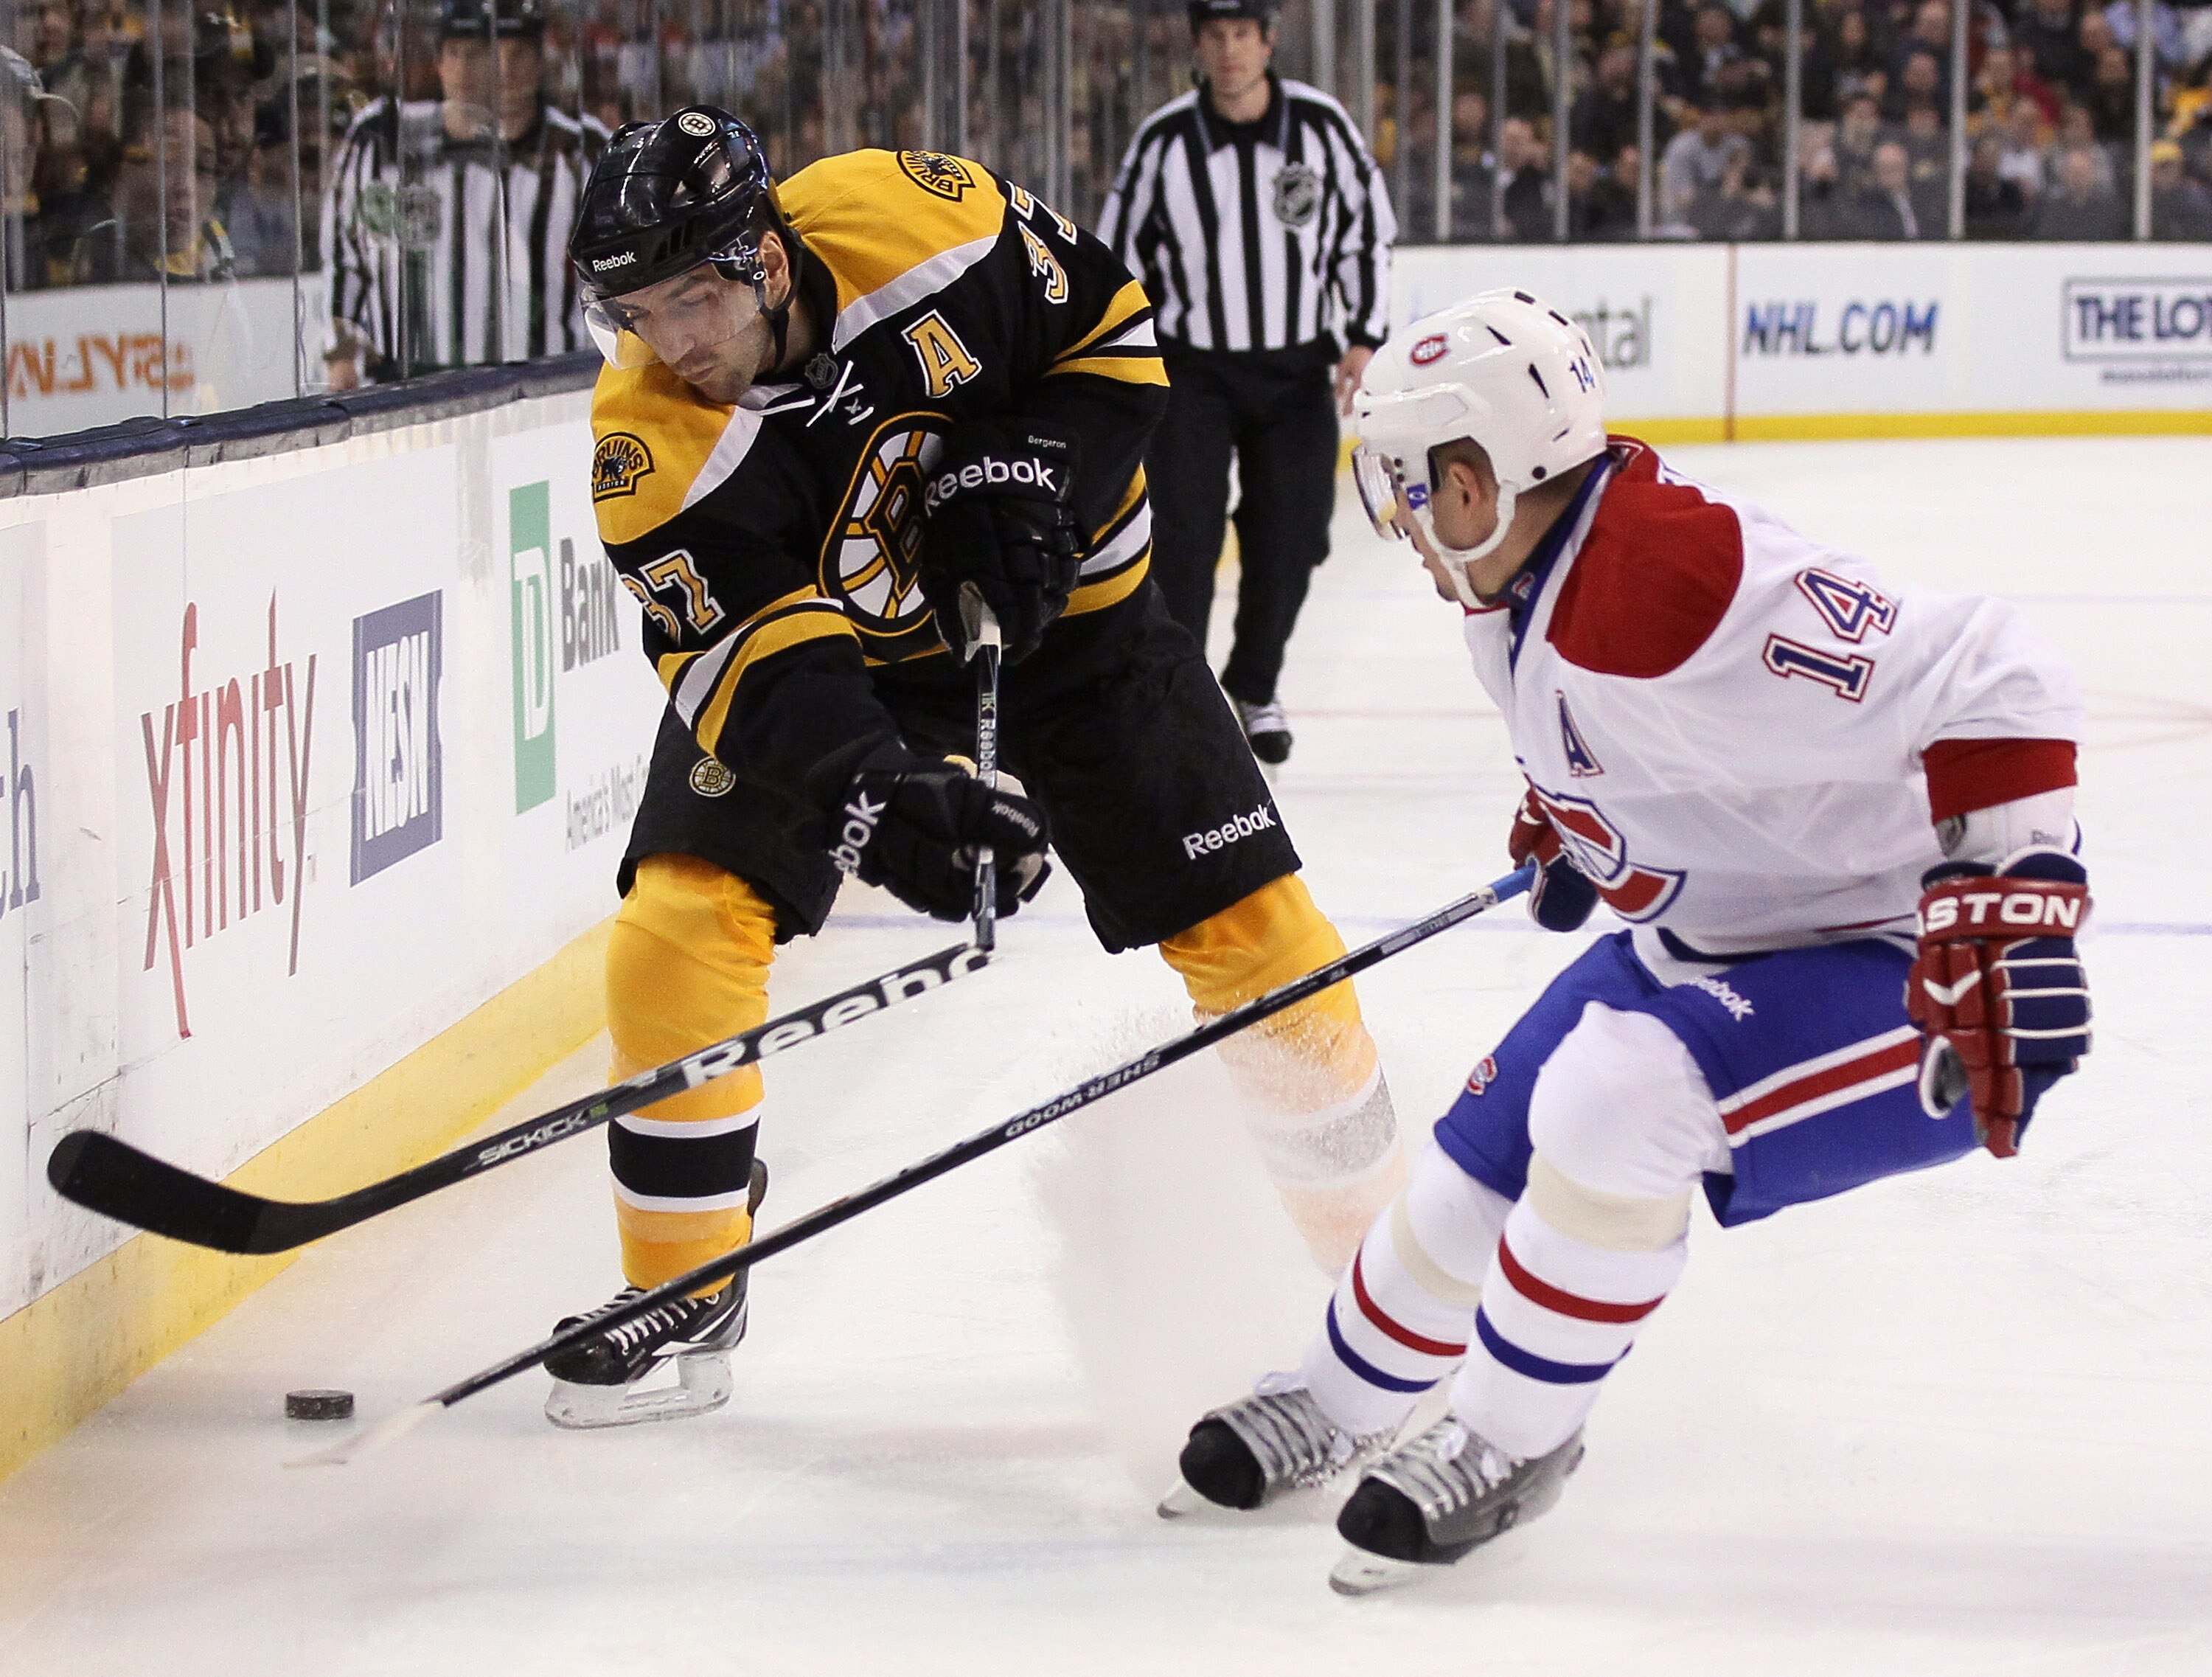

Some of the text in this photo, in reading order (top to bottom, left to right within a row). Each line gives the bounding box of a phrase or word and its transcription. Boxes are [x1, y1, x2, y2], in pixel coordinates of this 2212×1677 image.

[592, 251, 637, 273] Reebok
[1744, 301, 1939, 357] NHL.COM
[2076, 296, 2212, 340] THE LO
[901, 309, 983, 398] A
[1569, 355, 1596, 393] 14
[924, 456, 1057, 518] Reebok
[514, 537, 619, 741] TD Bank
[1762, 567, 1897, 703] 14
[366, 631, 429, 842] NESN
[1555, 690, 1604, 777] A
[142, 586, 318, 1041] xfinity
[991, 802, 1040, 838] Reebok
[1183, 803, 1276, 860] Reebok
